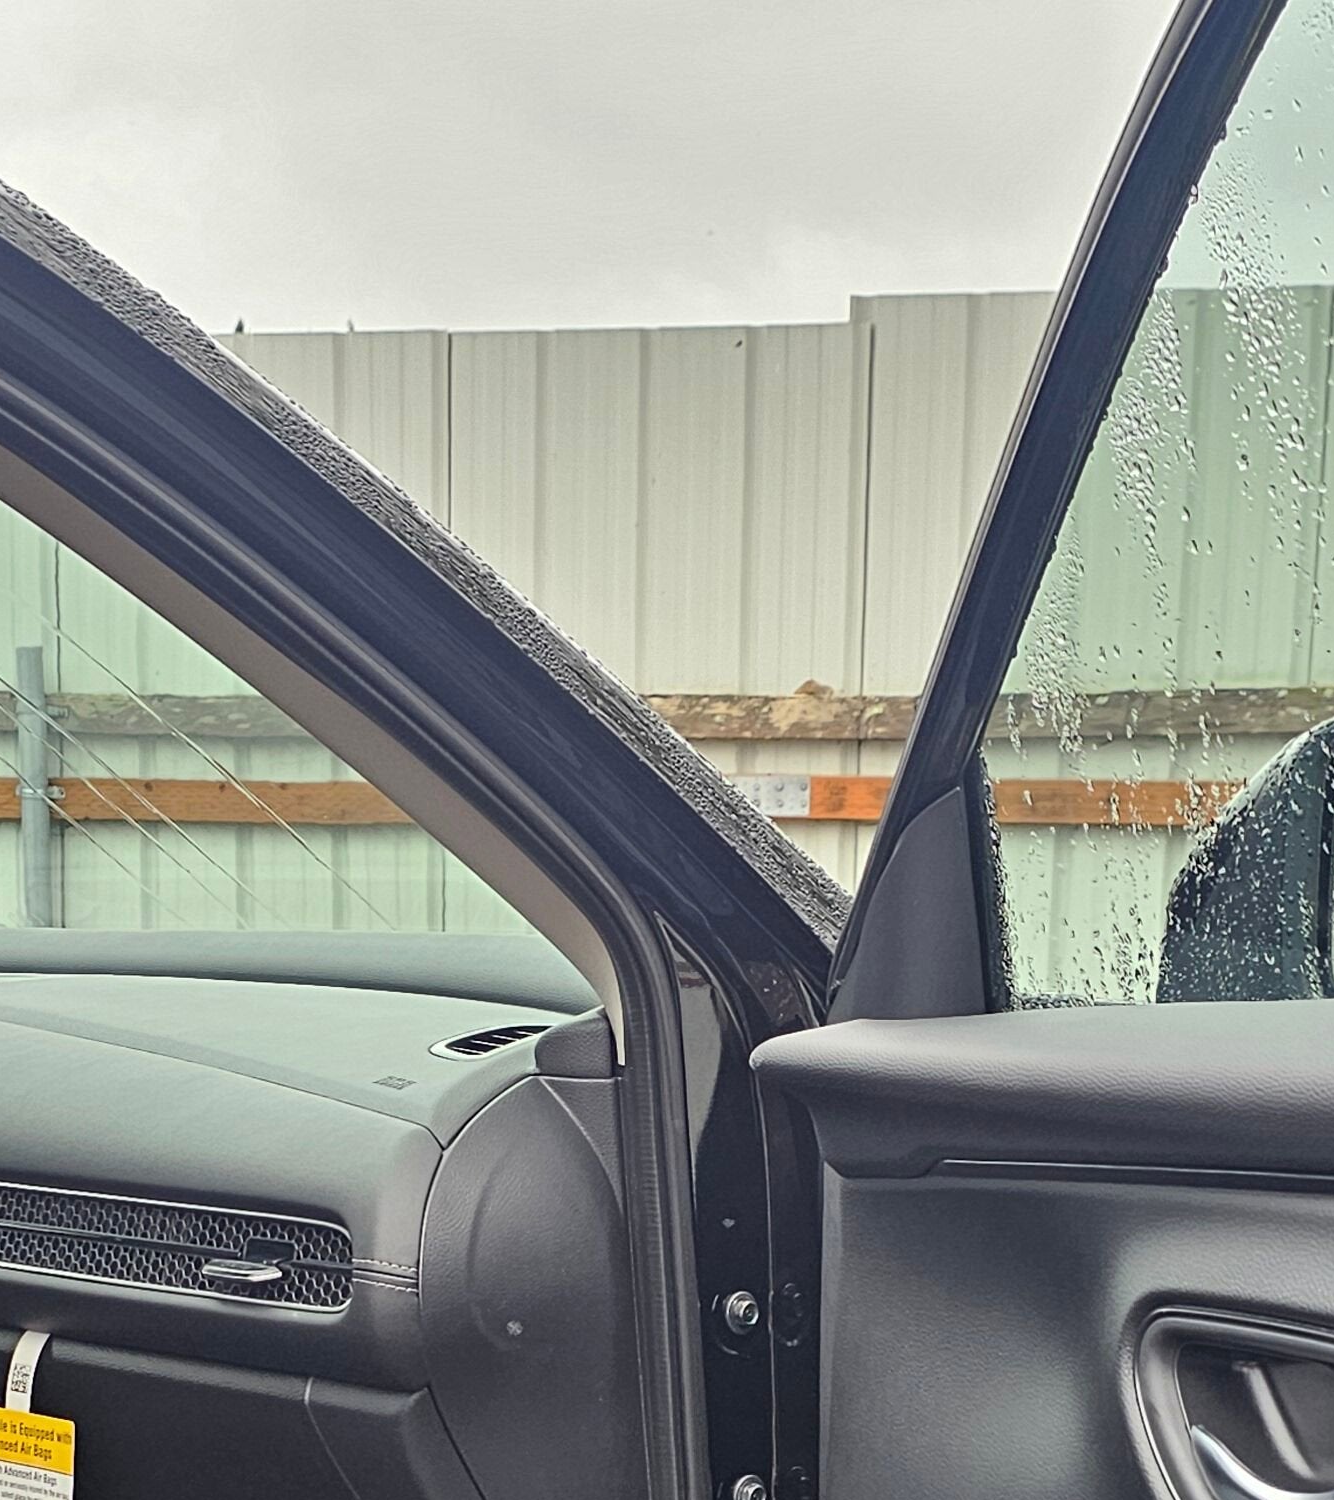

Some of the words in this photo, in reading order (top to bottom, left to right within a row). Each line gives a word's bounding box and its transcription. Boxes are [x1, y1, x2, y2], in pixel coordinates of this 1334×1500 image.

[10, 1420, 17, 1434] is
[20, 1422, 55, 1441] Equipped
[56, 1431, 72, 1445] with
[20, 1442, 31, 1454] Air
[34, 1444, 52, 1461] Bags
[4, 1465, 32, 1480] Advanced
